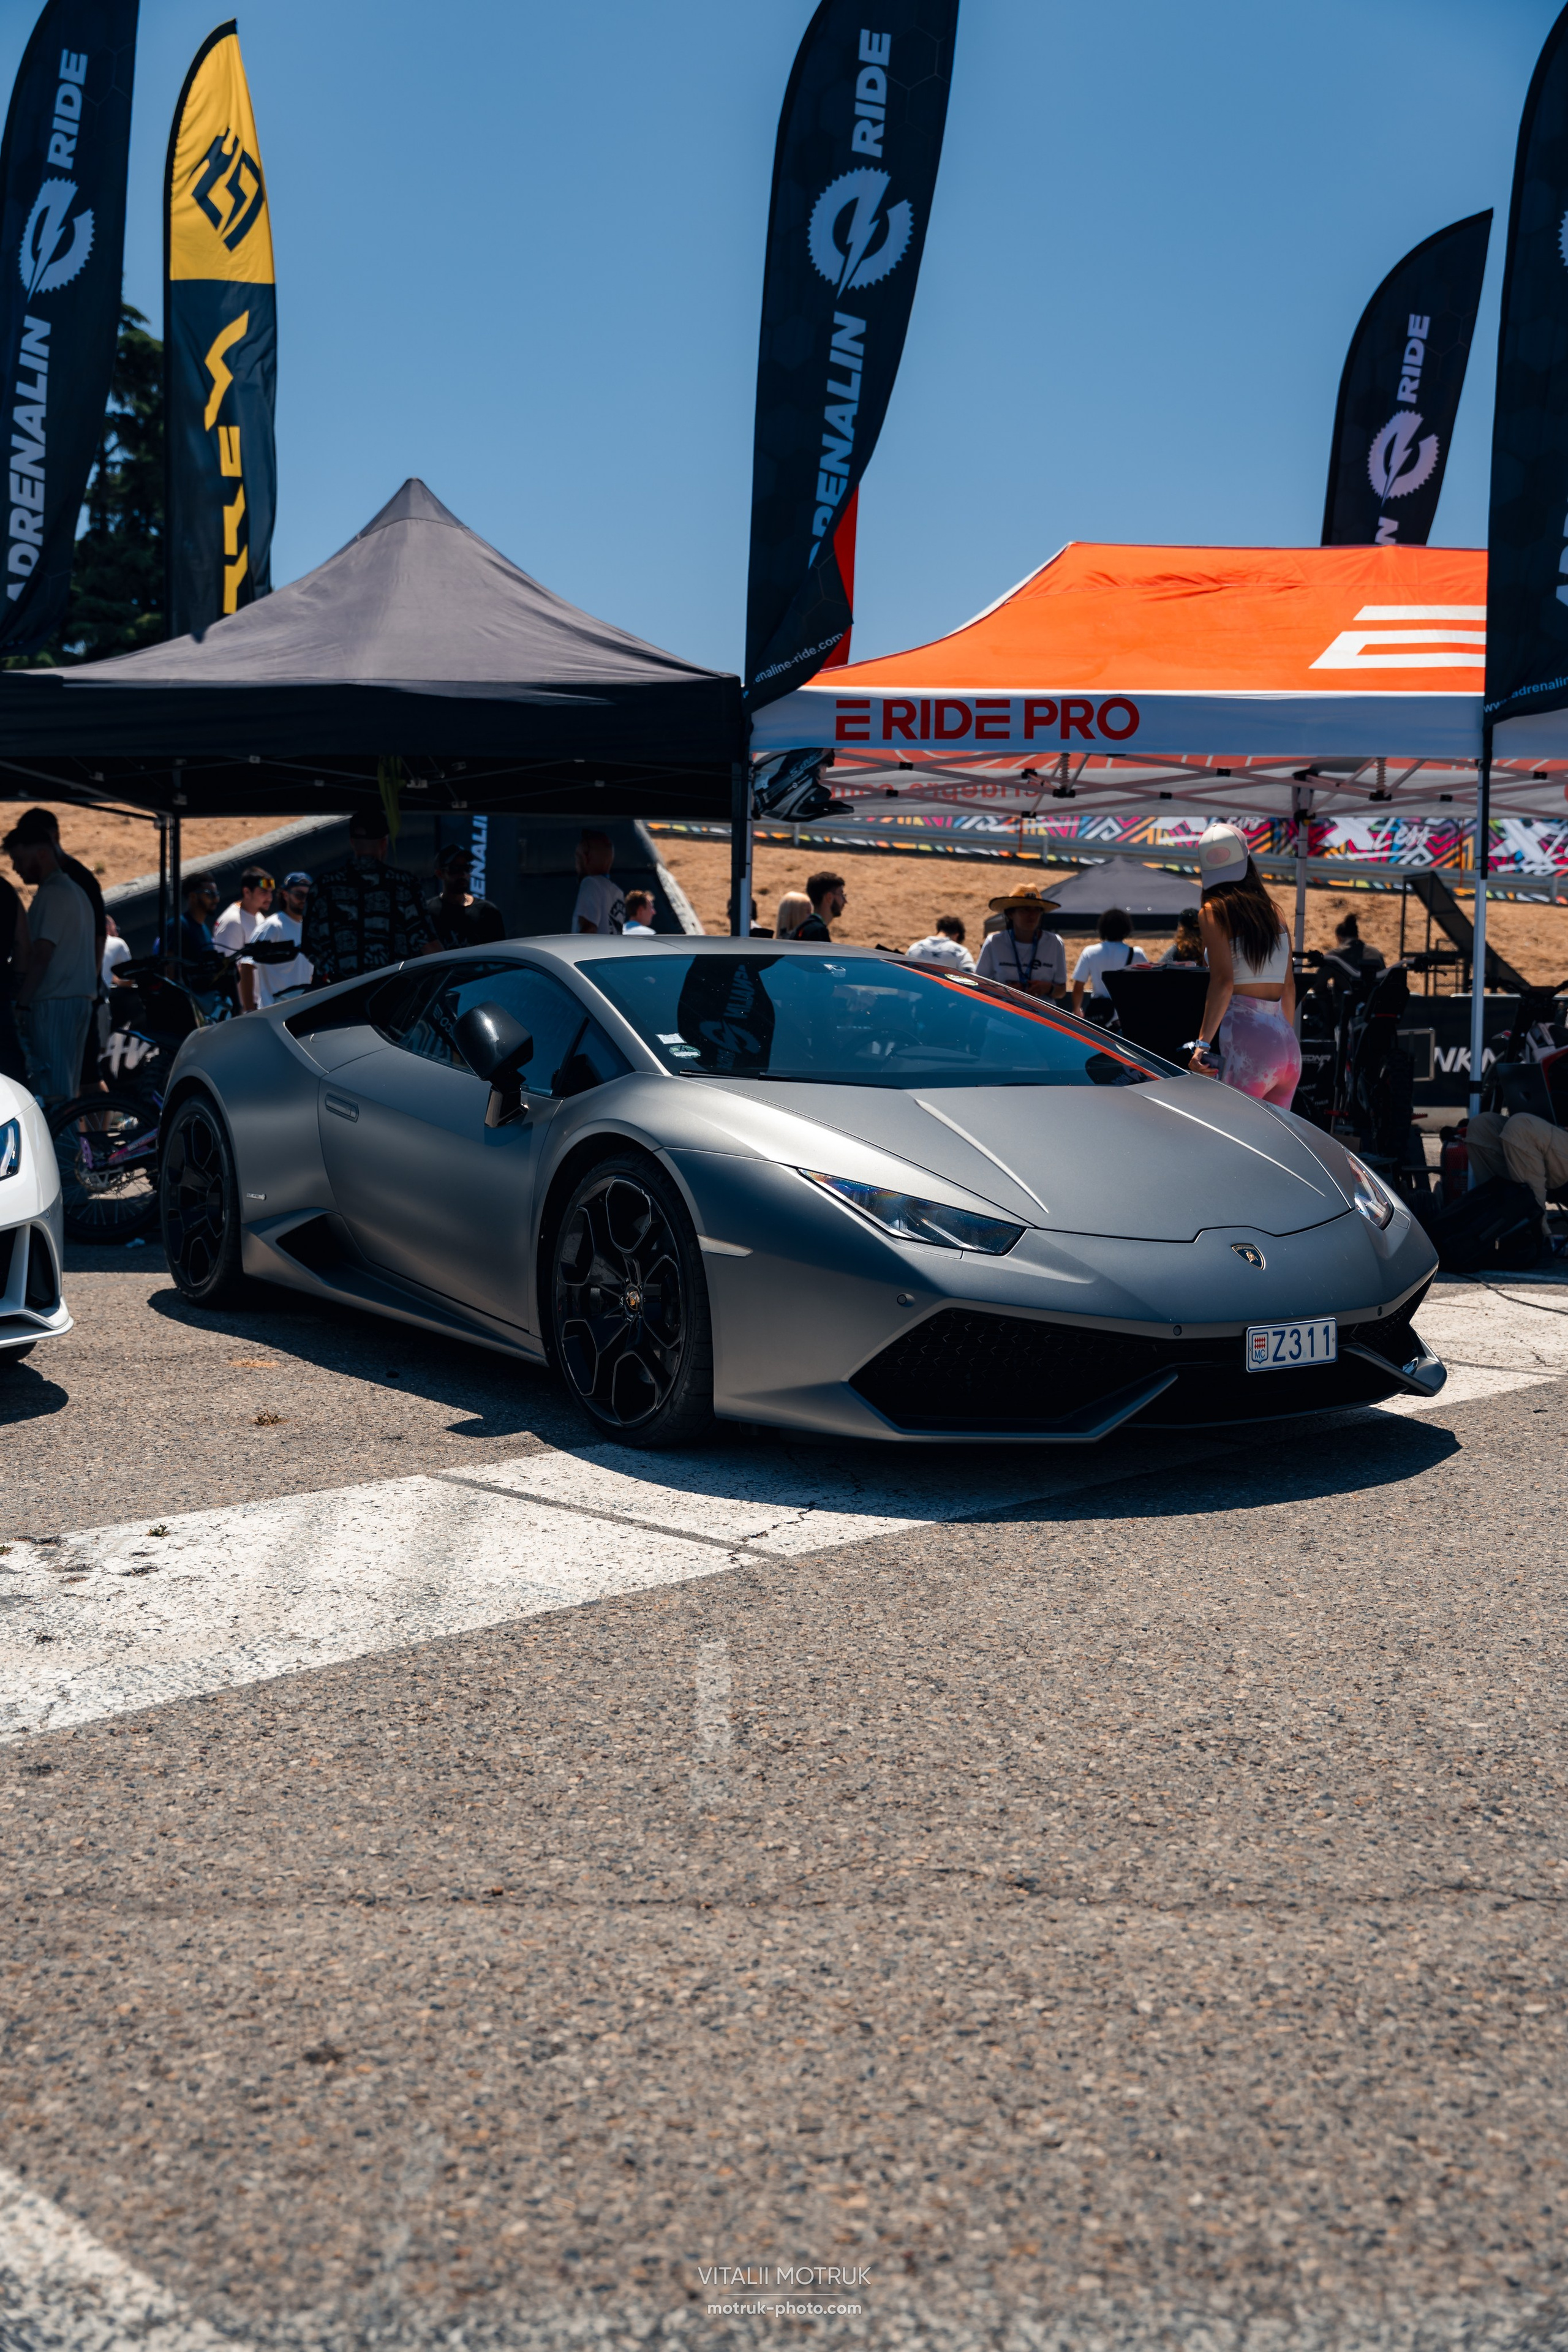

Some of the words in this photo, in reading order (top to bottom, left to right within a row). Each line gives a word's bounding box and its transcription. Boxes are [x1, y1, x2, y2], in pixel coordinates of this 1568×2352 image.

[48, 49, 88, 170] RIDE
[807, 311, 867, 570] RENALIN
[851, 28, 891, 158] RIDE
[1396, 313, 1430, 404] RIDE
[753, 633, 843, 684] enaline-ride.com
[883, 699, 1011, 741] RIDE
[1024, 697, 1140, 741] PRO
[1254, 1349, 1265, 1359] MC
[1272, 1324, 1330, 1363] Z311
